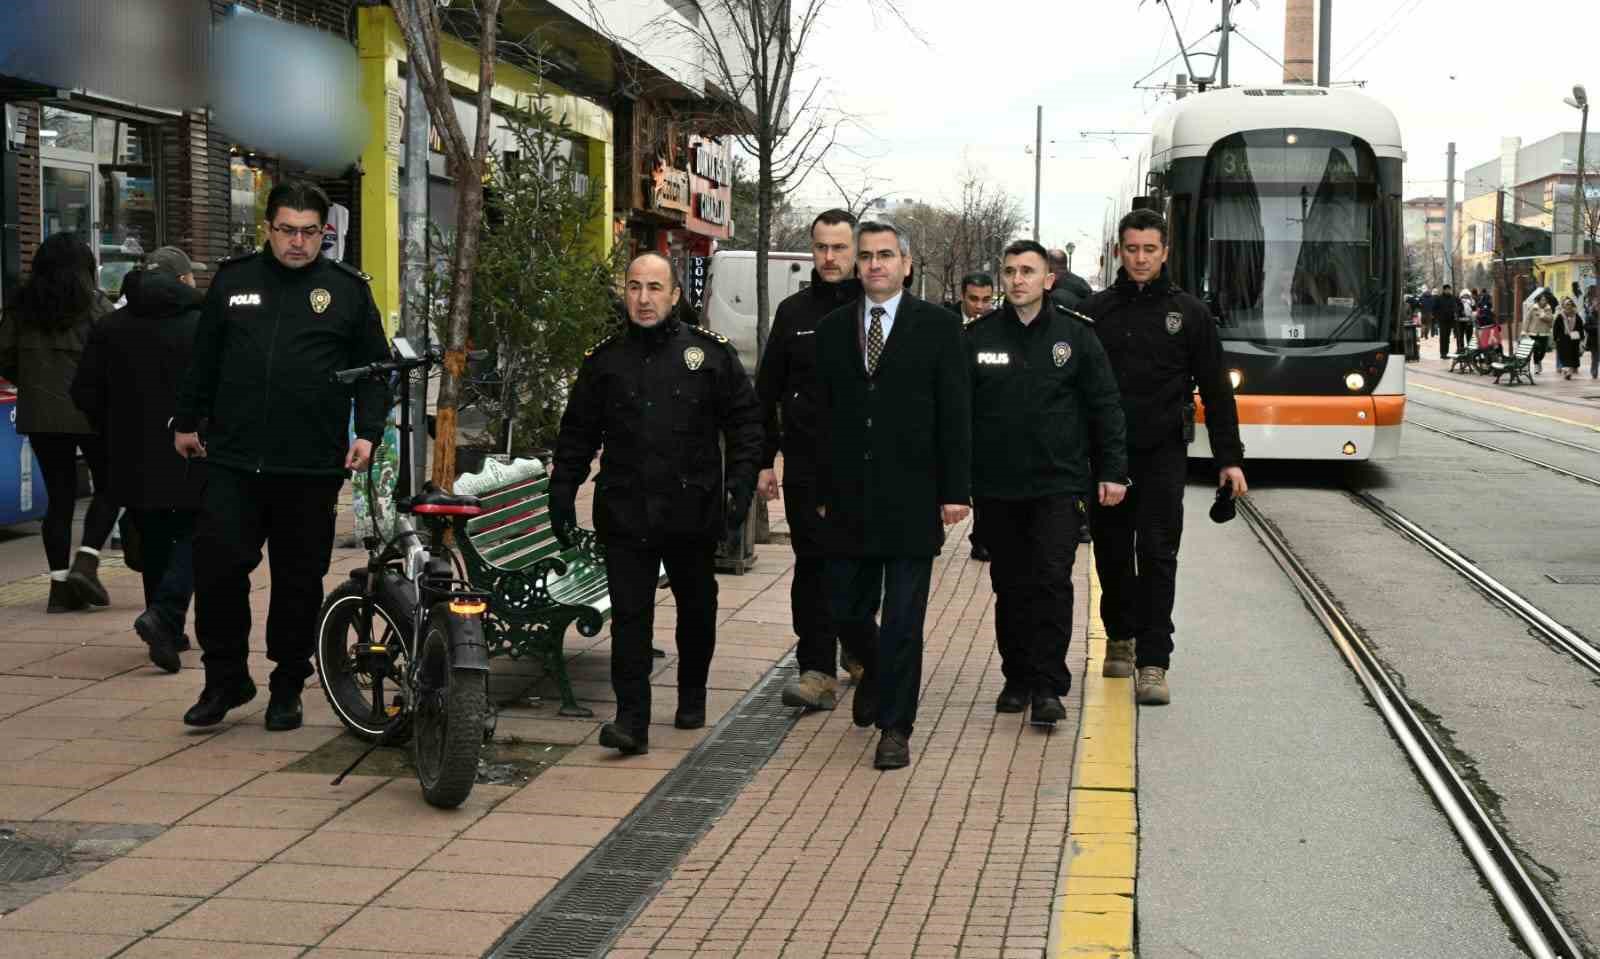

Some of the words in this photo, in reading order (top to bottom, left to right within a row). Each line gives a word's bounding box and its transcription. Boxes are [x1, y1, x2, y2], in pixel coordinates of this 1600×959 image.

[1223, 153, 1236, 174] 3
[695, 256, 704, 308] DÜNYA
[1288, 328, 1300, 338] 10
